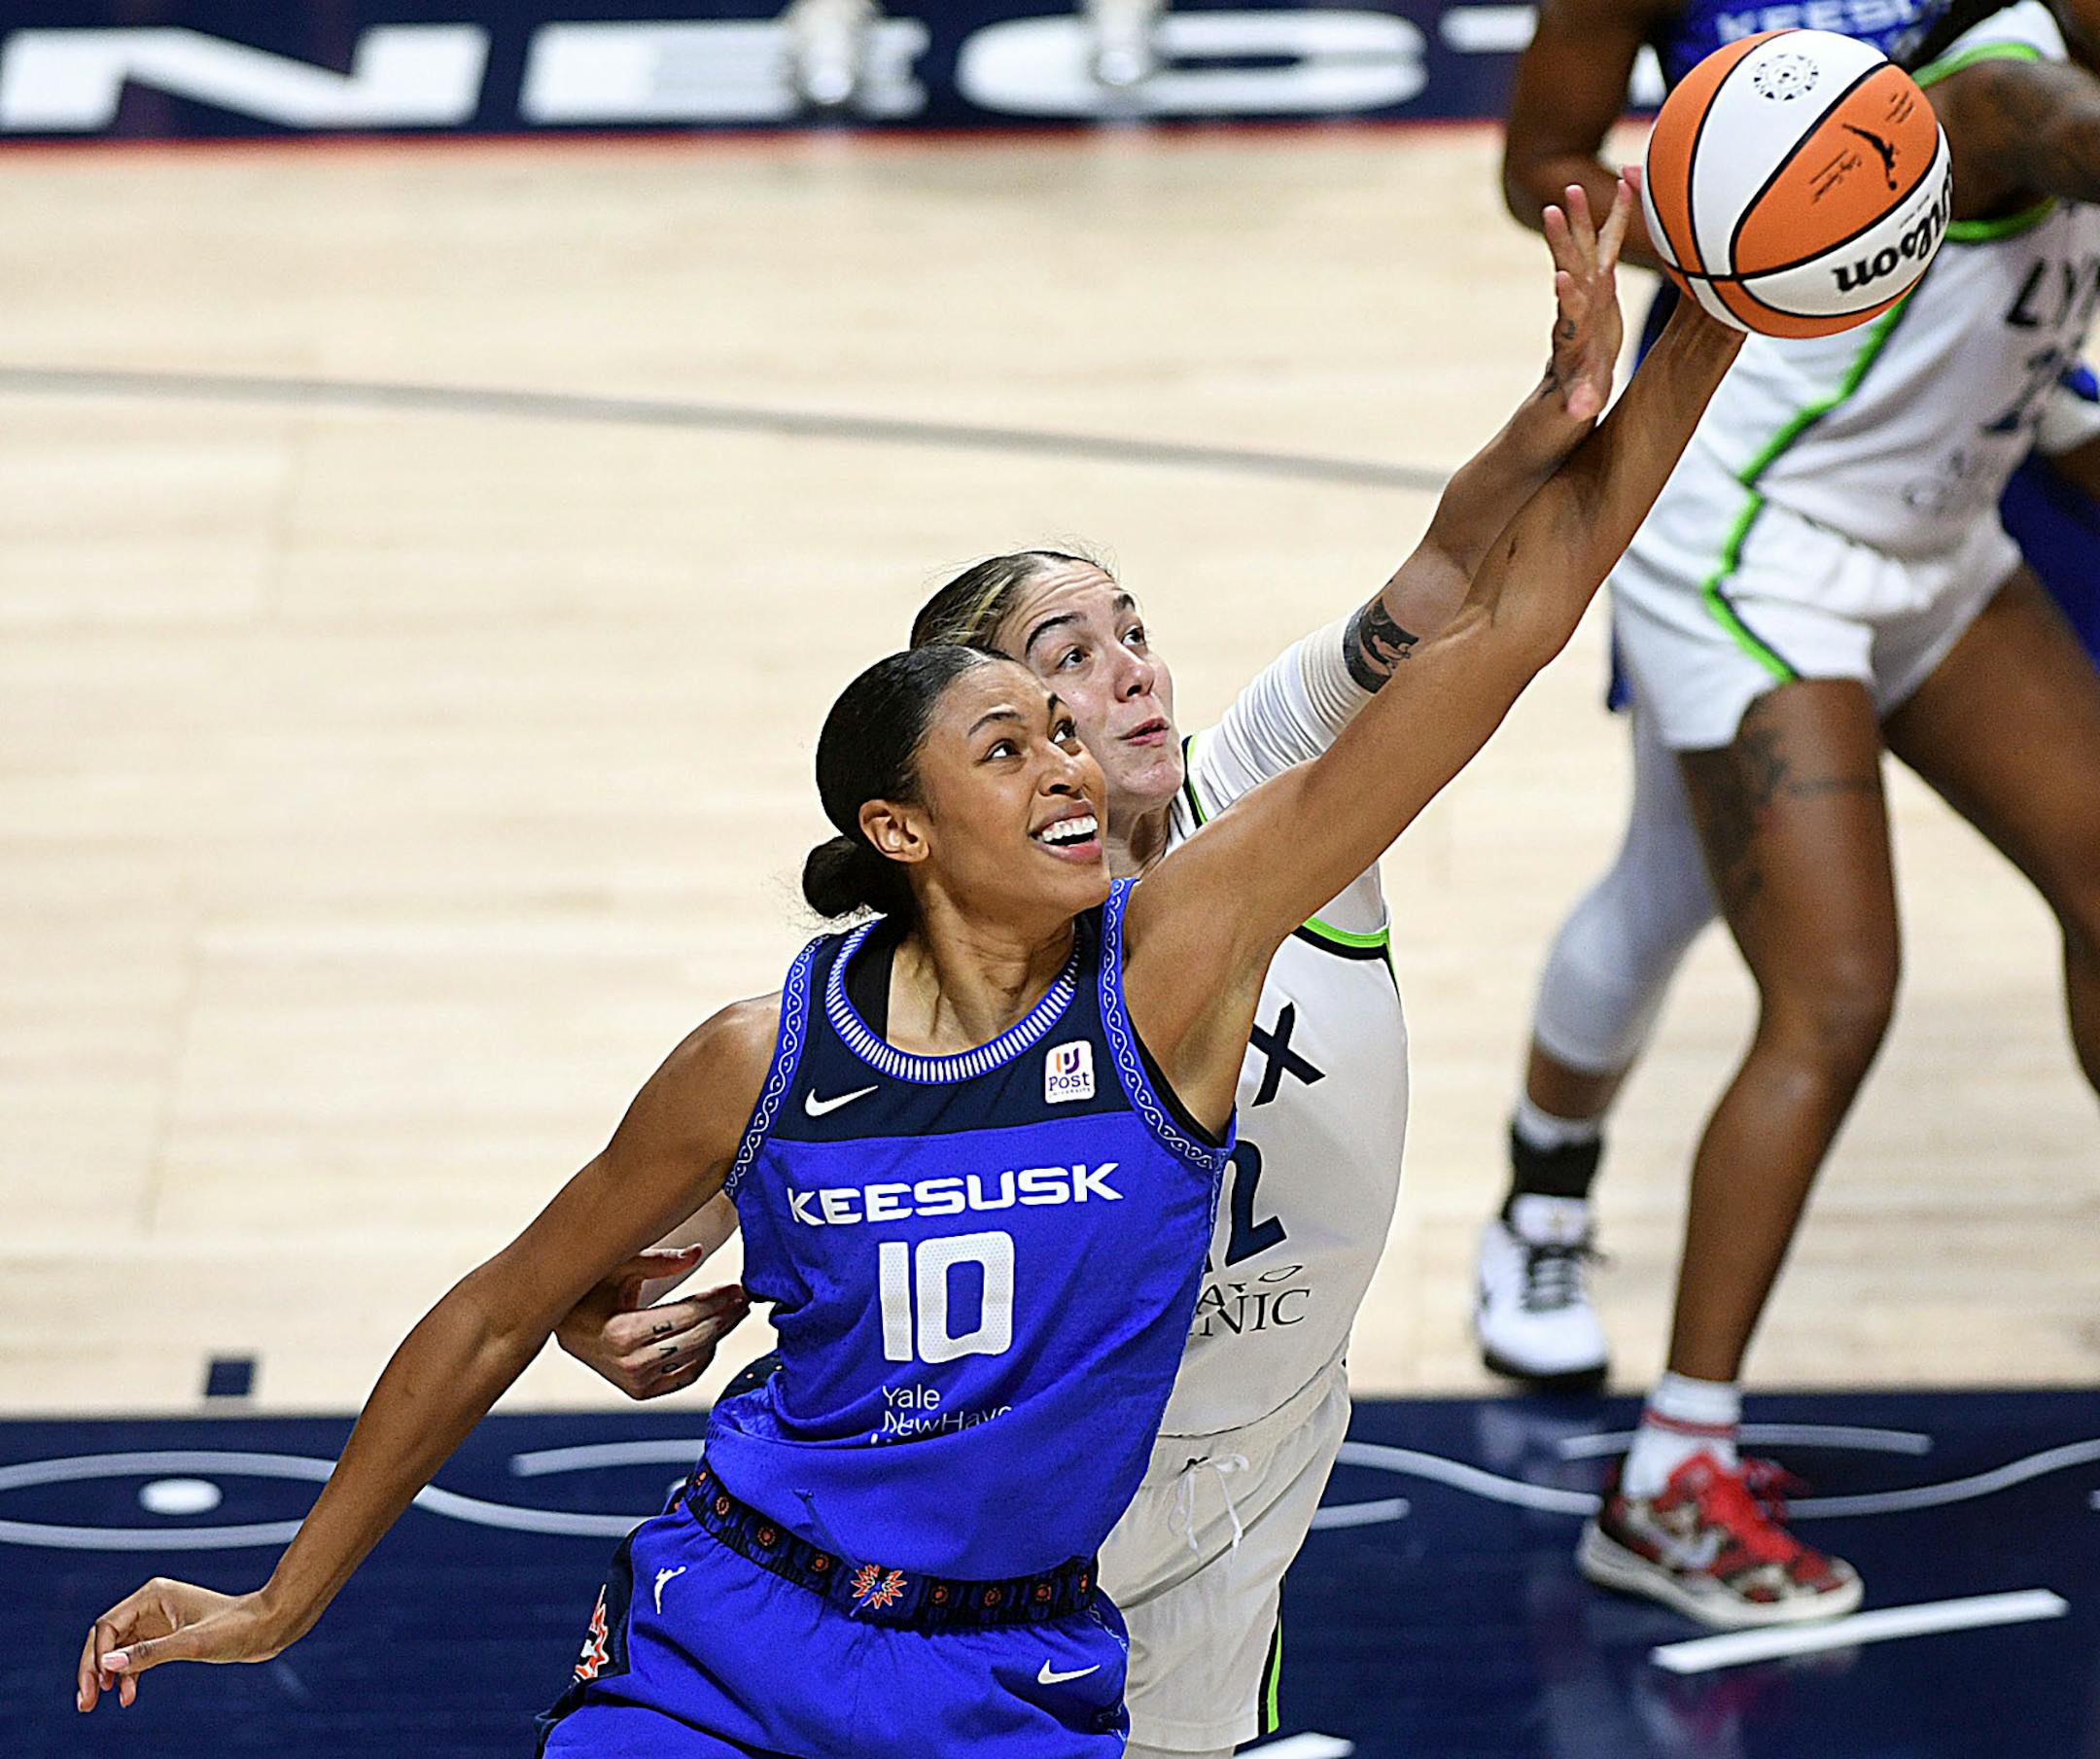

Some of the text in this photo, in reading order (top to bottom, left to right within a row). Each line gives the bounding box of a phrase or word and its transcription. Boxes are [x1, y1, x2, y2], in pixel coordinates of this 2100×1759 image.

[788, 1162, 1124, 1226] KEESUSK
[1205, 1139, 1287, 1272] 2
[879, 1230, 1014, 1363] 10
[1188, 1288, 1311, 1337] NIC
[882, 1383, 940, 1410] Yale
